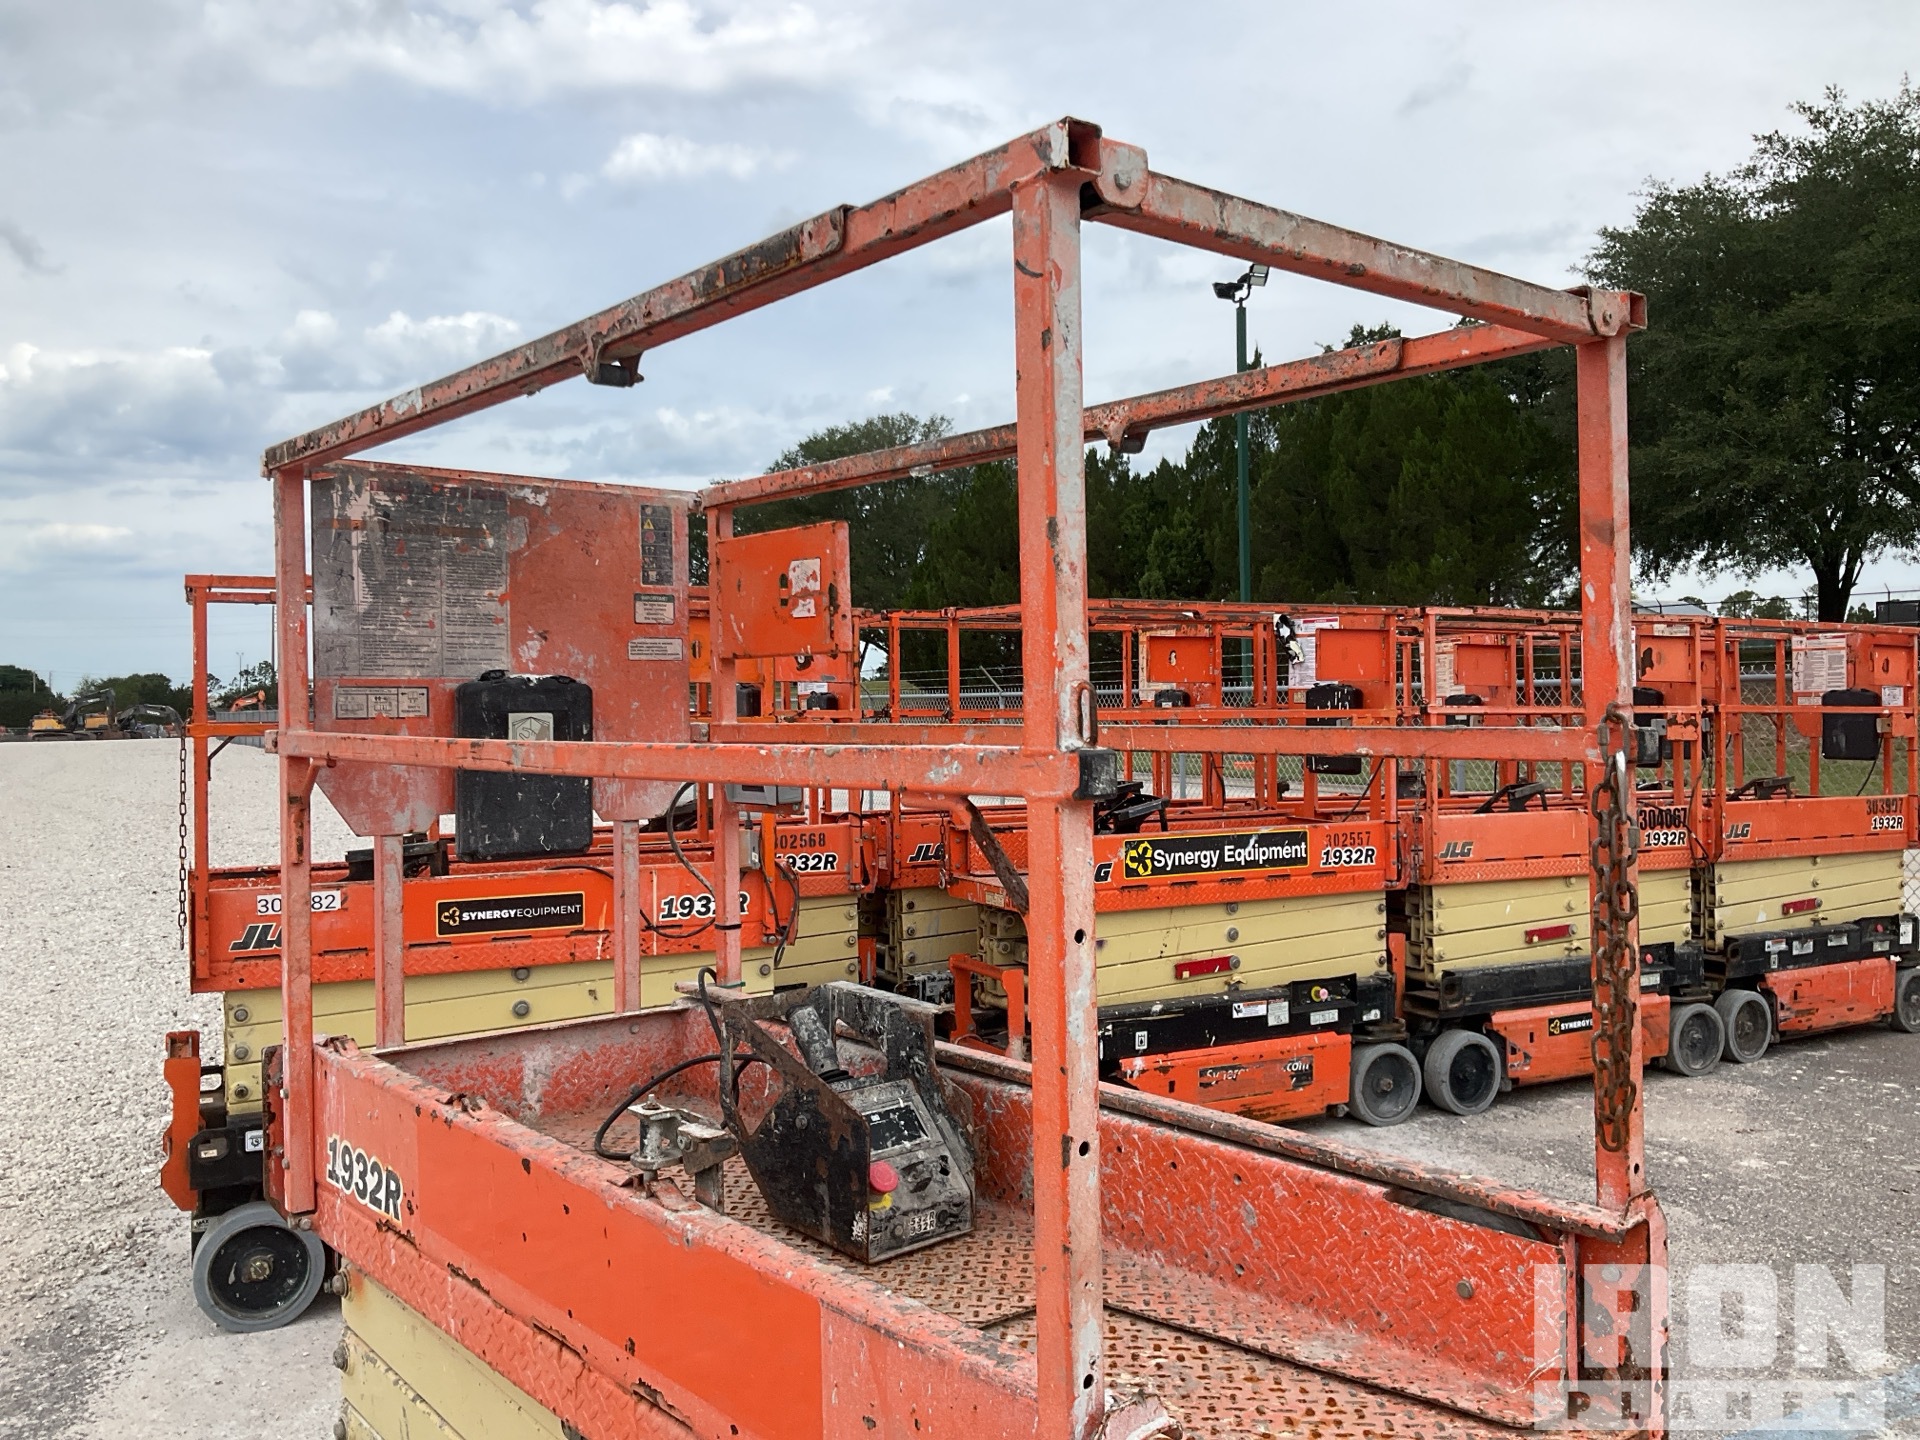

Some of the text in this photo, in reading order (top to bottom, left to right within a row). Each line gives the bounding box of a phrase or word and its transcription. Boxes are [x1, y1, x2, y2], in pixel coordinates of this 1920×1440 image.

[1725, 823, 1752, 839] JLG
[1871, 816, 1904, 830] 1932R
[775, 832, 826, 849] 02568
[1325, 831, 1371, 847] 302557
[1644, 831, 1687, 847] 1932R
[1153, 841, 1307, 870] Synergy Equipment
[1320, 847, 1376, 867] 1932R
[1439, 841, 1473, 859] JLG
[257, 894, 337, 914] 3082
[659, 892, 750, 920] 193
[228, 922, 282, 951] JL
[326, 1133, 403, 1225] 1932R
